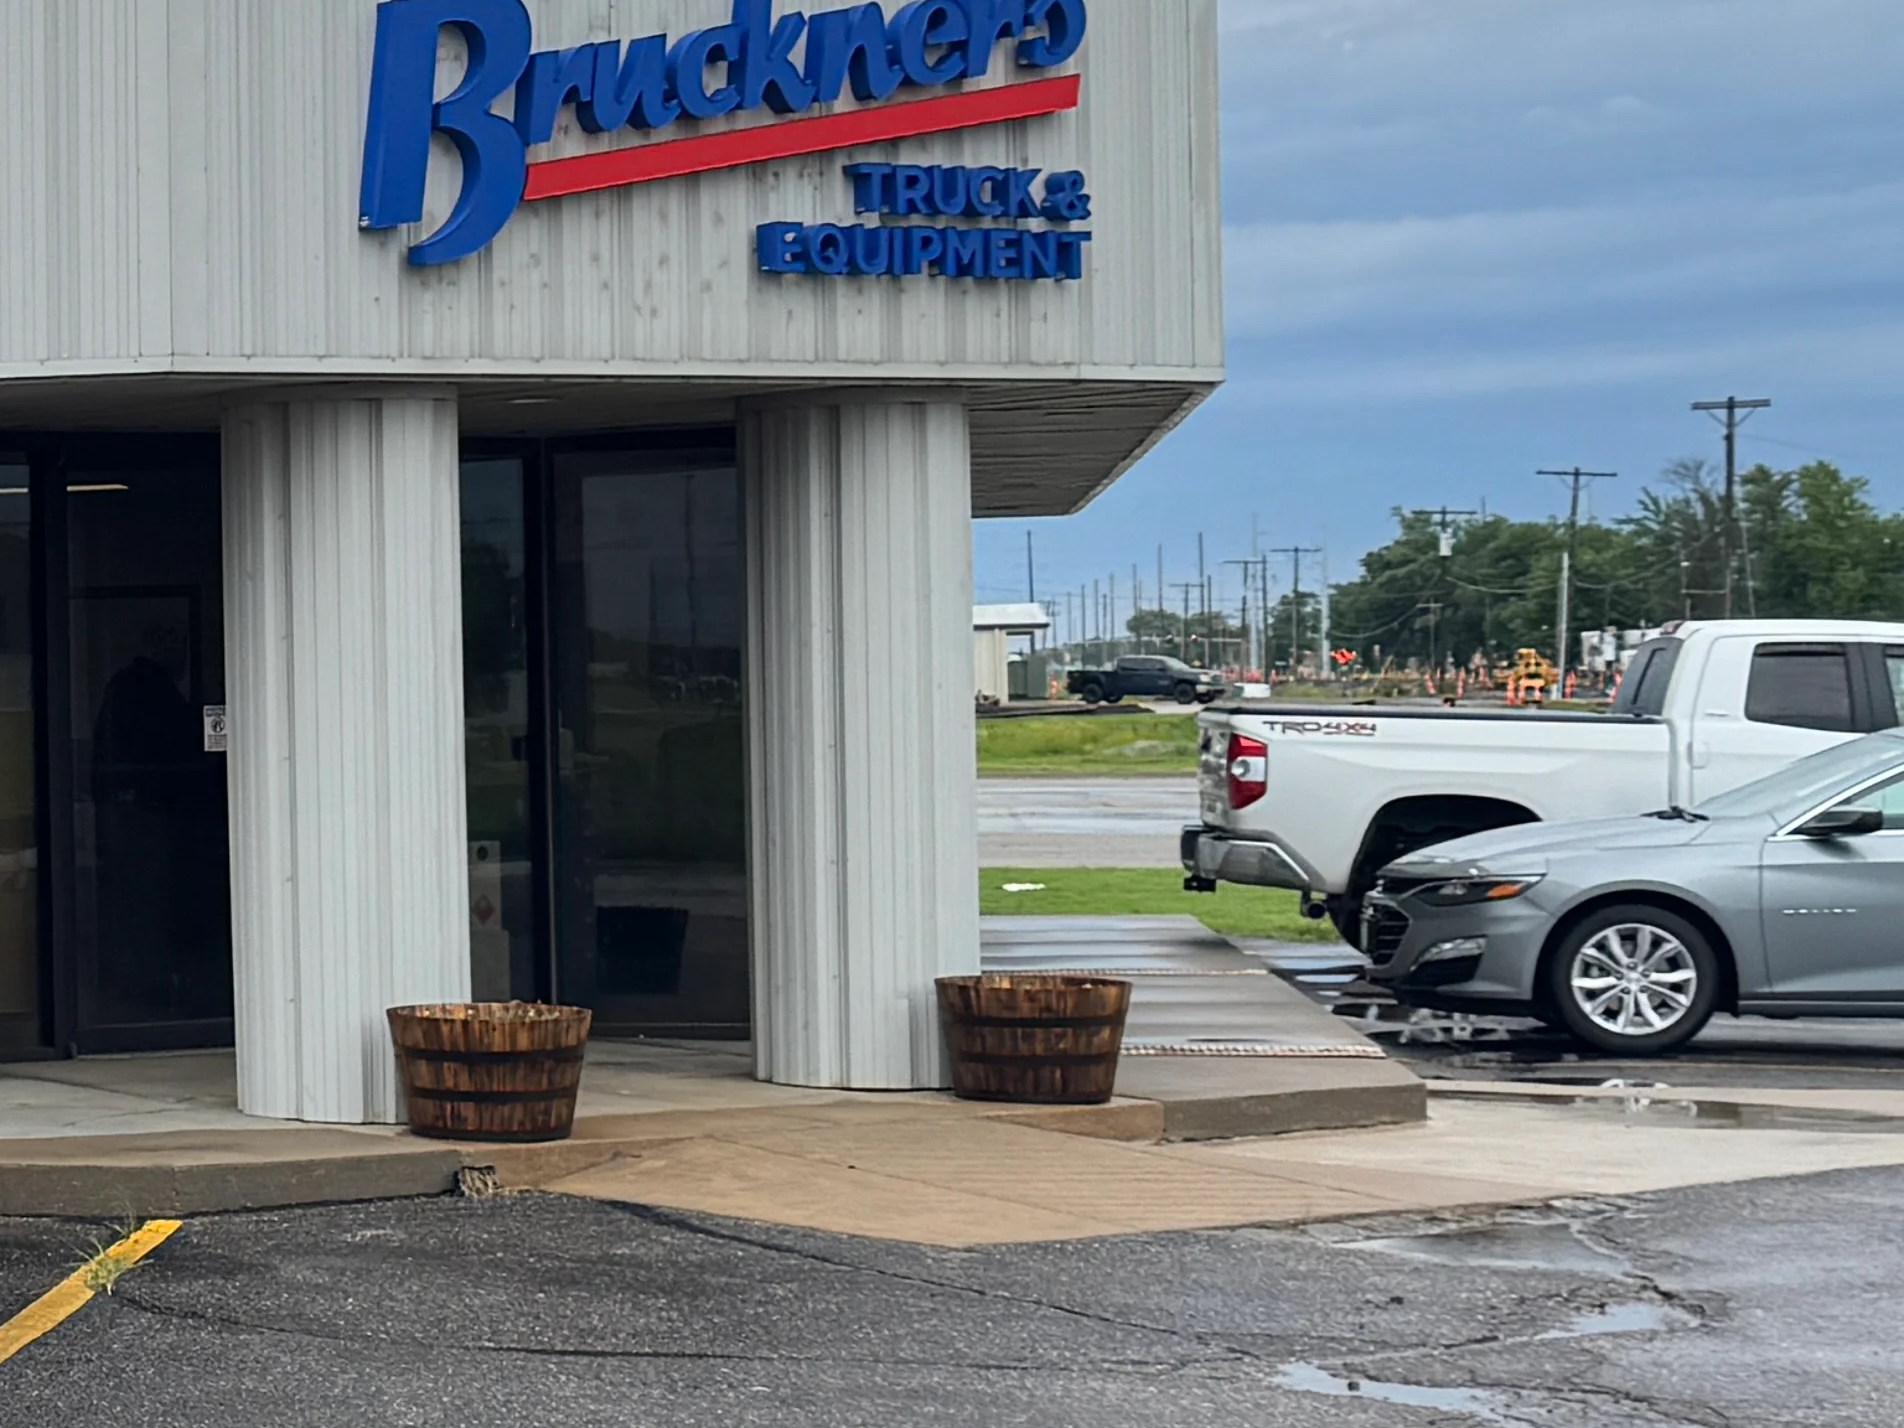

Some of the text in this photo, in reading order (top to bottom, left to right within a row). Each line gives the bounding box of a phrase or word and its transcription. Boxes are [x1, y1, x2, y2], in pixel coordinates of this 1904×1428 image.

[844, 162, 1092, 222] TRUCK &
[756, 221, 1092, 281] EQUIPMENT
